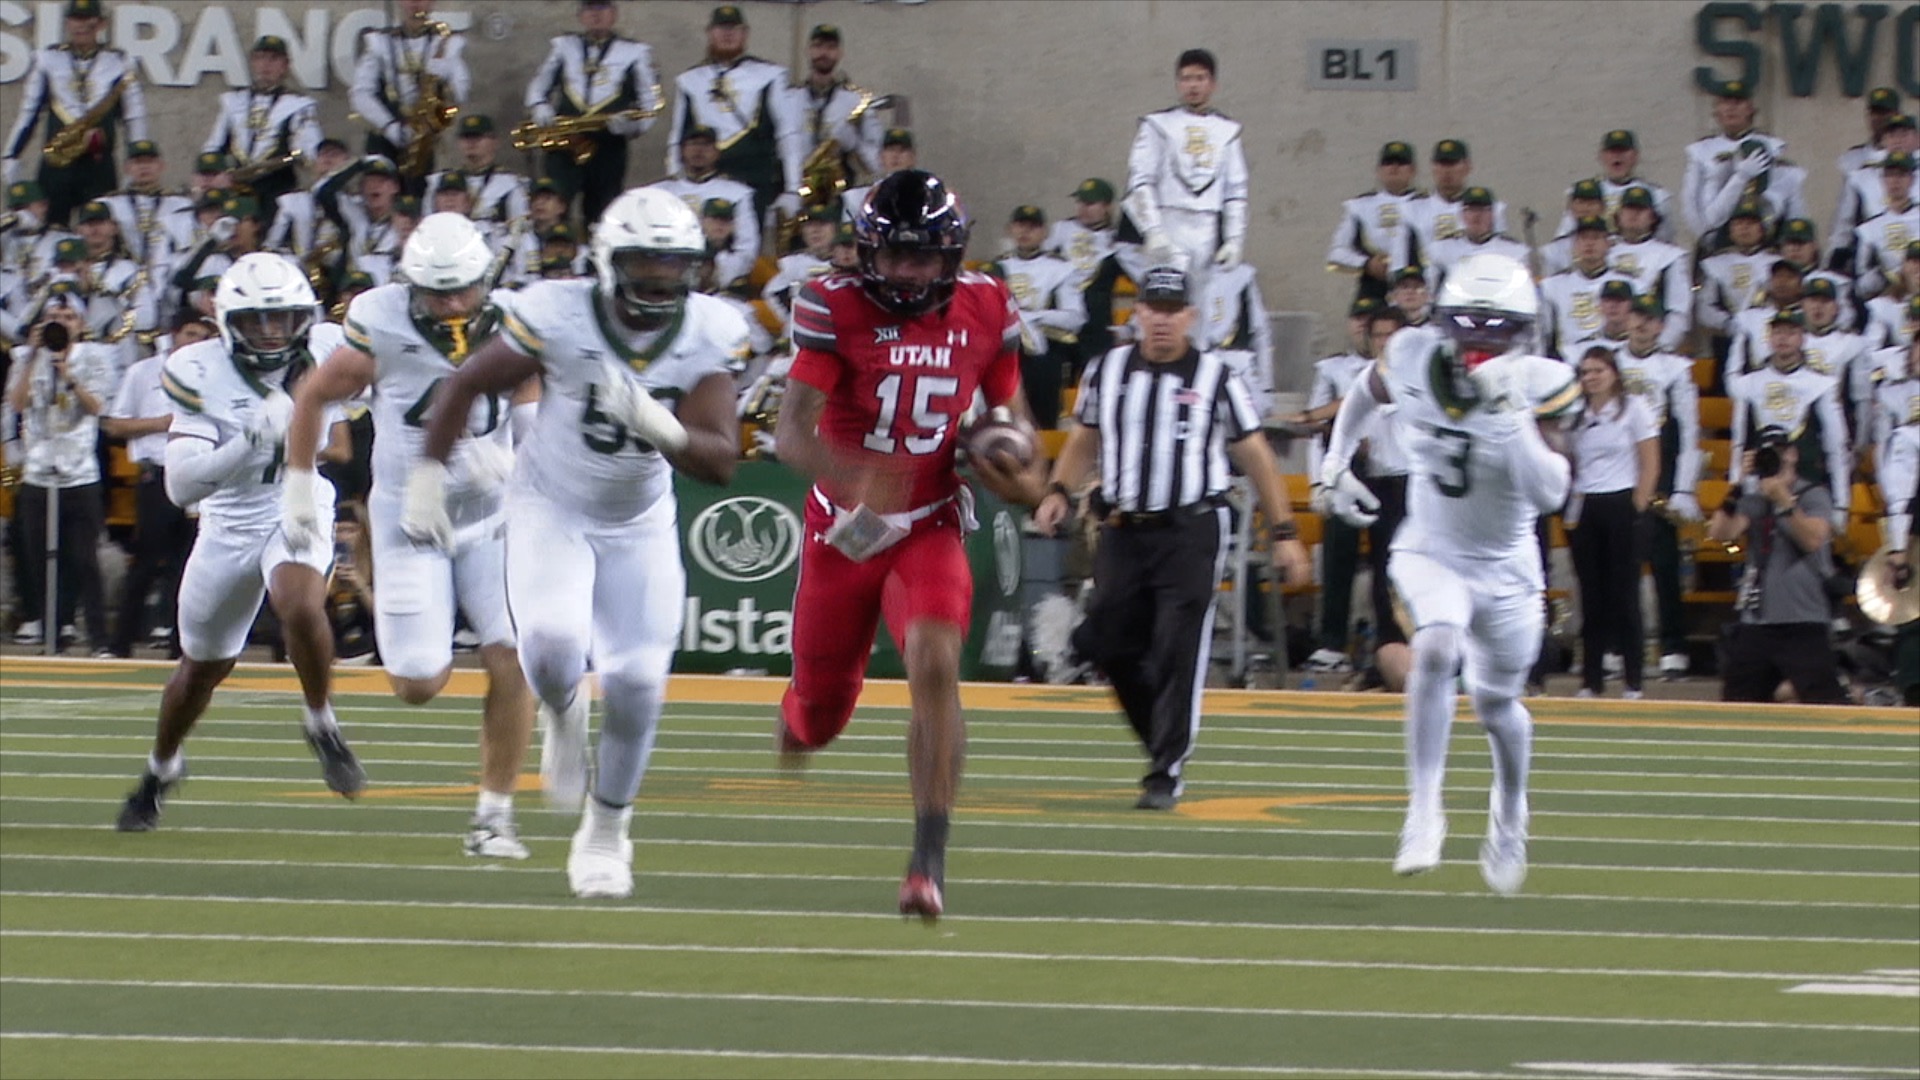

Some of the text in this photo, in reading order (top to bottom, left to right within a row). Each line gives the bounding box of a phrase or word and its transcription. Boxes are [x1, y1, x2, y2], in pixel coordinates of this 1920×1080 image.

[1323, 49, 1399, 80] BL1
[889, 345, 951, 368] UTAH
[862, 374, 958, 455] 15
[1429, 425, 1471, 498] 3
